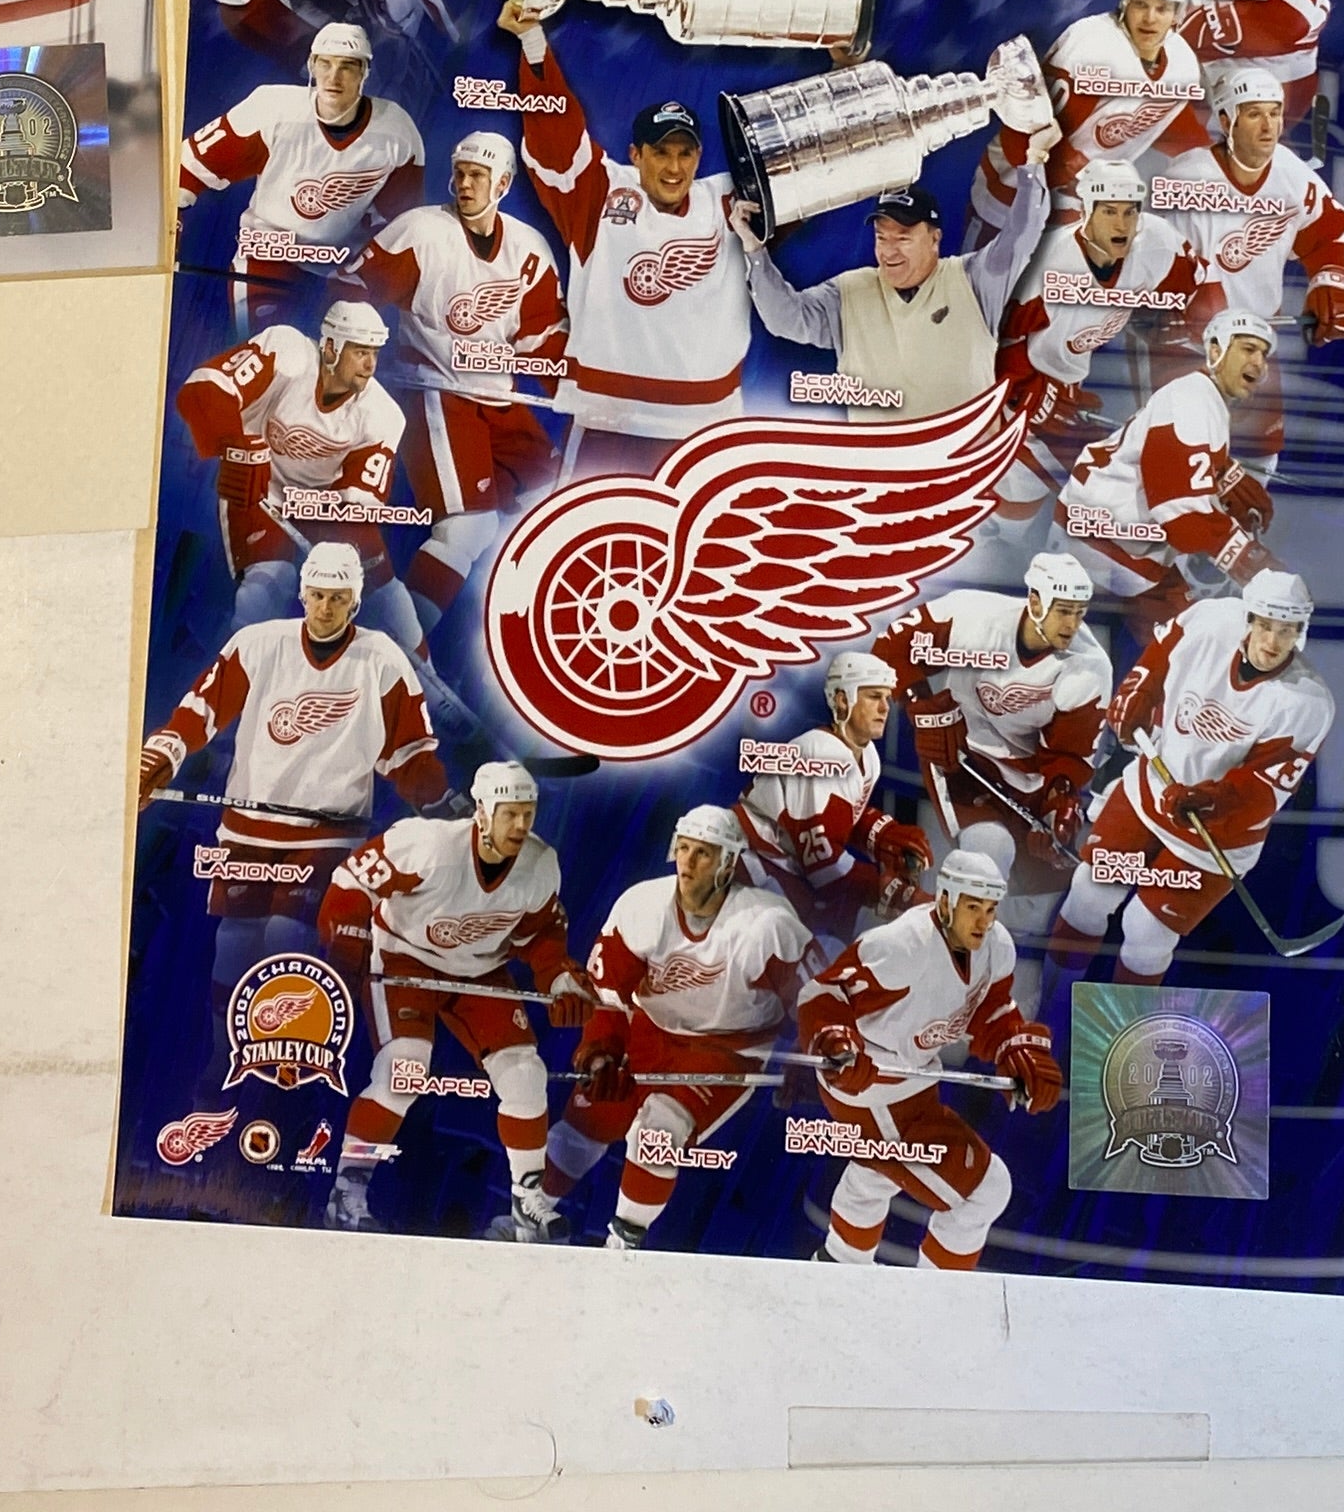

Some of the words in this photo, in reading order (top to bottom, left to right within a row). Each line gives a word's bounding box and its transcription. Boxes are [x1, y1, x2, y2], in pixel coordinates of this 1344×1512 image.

[454, 76, 505, 94] Steve
[1074, 79, 1205, 100] ROBITAILLE
[453, 91, 566, 115] YZERMAN
[1153, 177, 1229, 195] Brendan
[1151, 192, 1285, 215] SHANAHAN
[1304, 181, 1317, 215] A
[239, 243, 350, 265] FEDOROV
[520, 251, 540, 285] A
[1044, 272, 1091, 290] Boyd
[1044, 286, 1186, 310] DEVEREAUX
[453, 339, 515, 359] Nicklas
[222, 349, 263, 386] 96
[452, 356, 567, 377] LIDSTROM
[790, 371, 863, 391] Scotty
[789, 386, 903, 408] BOWMAN
[1188, 452, 1216, 489] 2
[283, 486, 342, 504] Tomas
[282, 501, 432, 526] HOLMSTROM
[1068, 504, 1112, 522] Chris
[1066, 519, 1166, 542] CHELIOS
[910, 647, 1009, 671] FISCHER
[739, 739, 799, 757] Darren
[194, 845, 230, 863] Igor
[798, 826, 833, 864] 25
[347, 848, 392, 890] 33
[1092, 848, 1145, 868] Pavel
[193, 861, 314, 884] LARIONOV
[1091, 865, 1201, 890] DATSYUK
[235, 986, 255, 1040] 2002
[257, 961, 347, 1046] CHAMPIONS
[242, 1041, 304, 1066] STANLEY
[305, 1044, 334, 1068] CUP
[392, 1058, 426, 1075] Kris
[391, 1075, 491, 1099] DRAPER
[638, 1129, 672, 1147] Kirk
[786, 1117, 861, 1138] Mathieu
[638, 1145, 737, 1170] MALTBY
[785, 1135, 947, 1164] DANDENAULT
